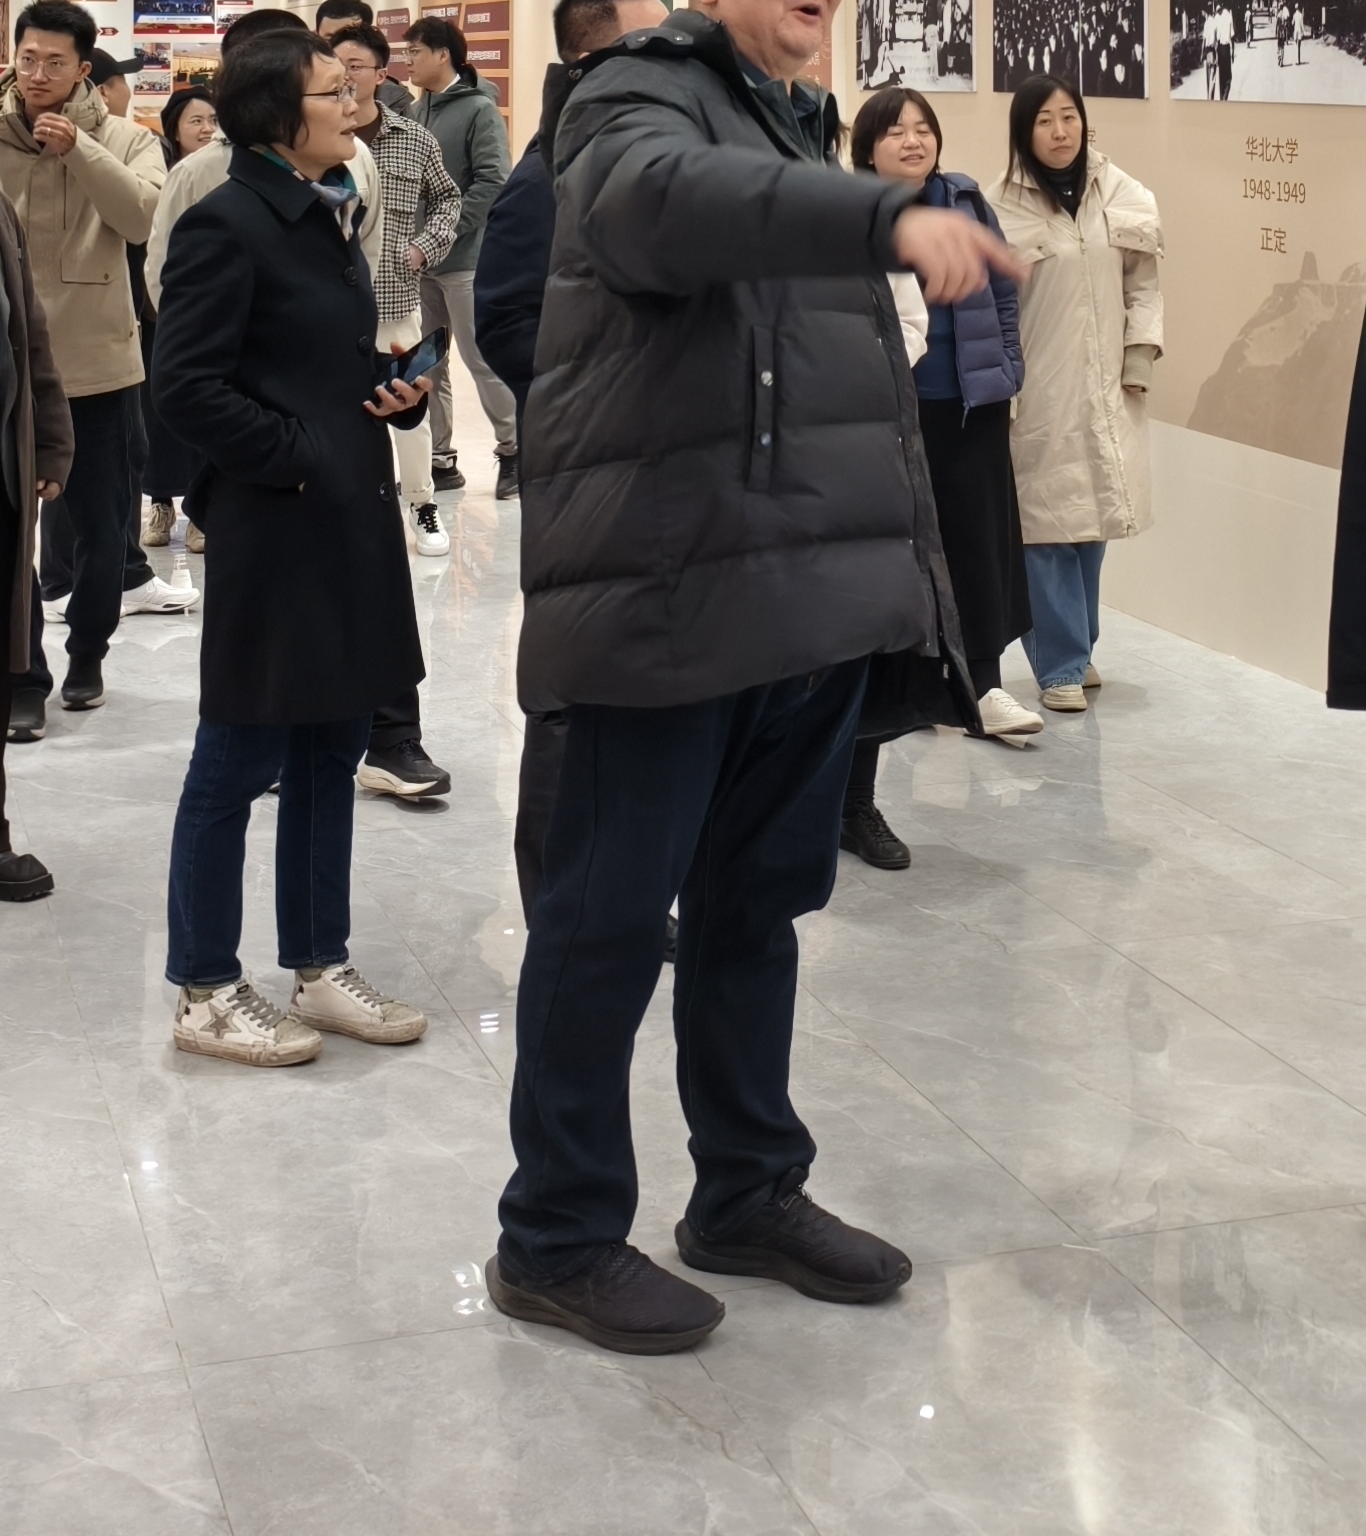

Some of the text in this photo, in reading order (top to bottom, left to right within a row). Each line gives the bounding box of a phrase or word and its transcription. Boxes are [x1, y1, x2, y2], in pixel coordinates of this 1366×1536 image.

[1245, 136, 1299, 164] 华北大学
[1242, 178, 1306, 204] 1948-1949
[1260, 227, 1287, 254] 正定
